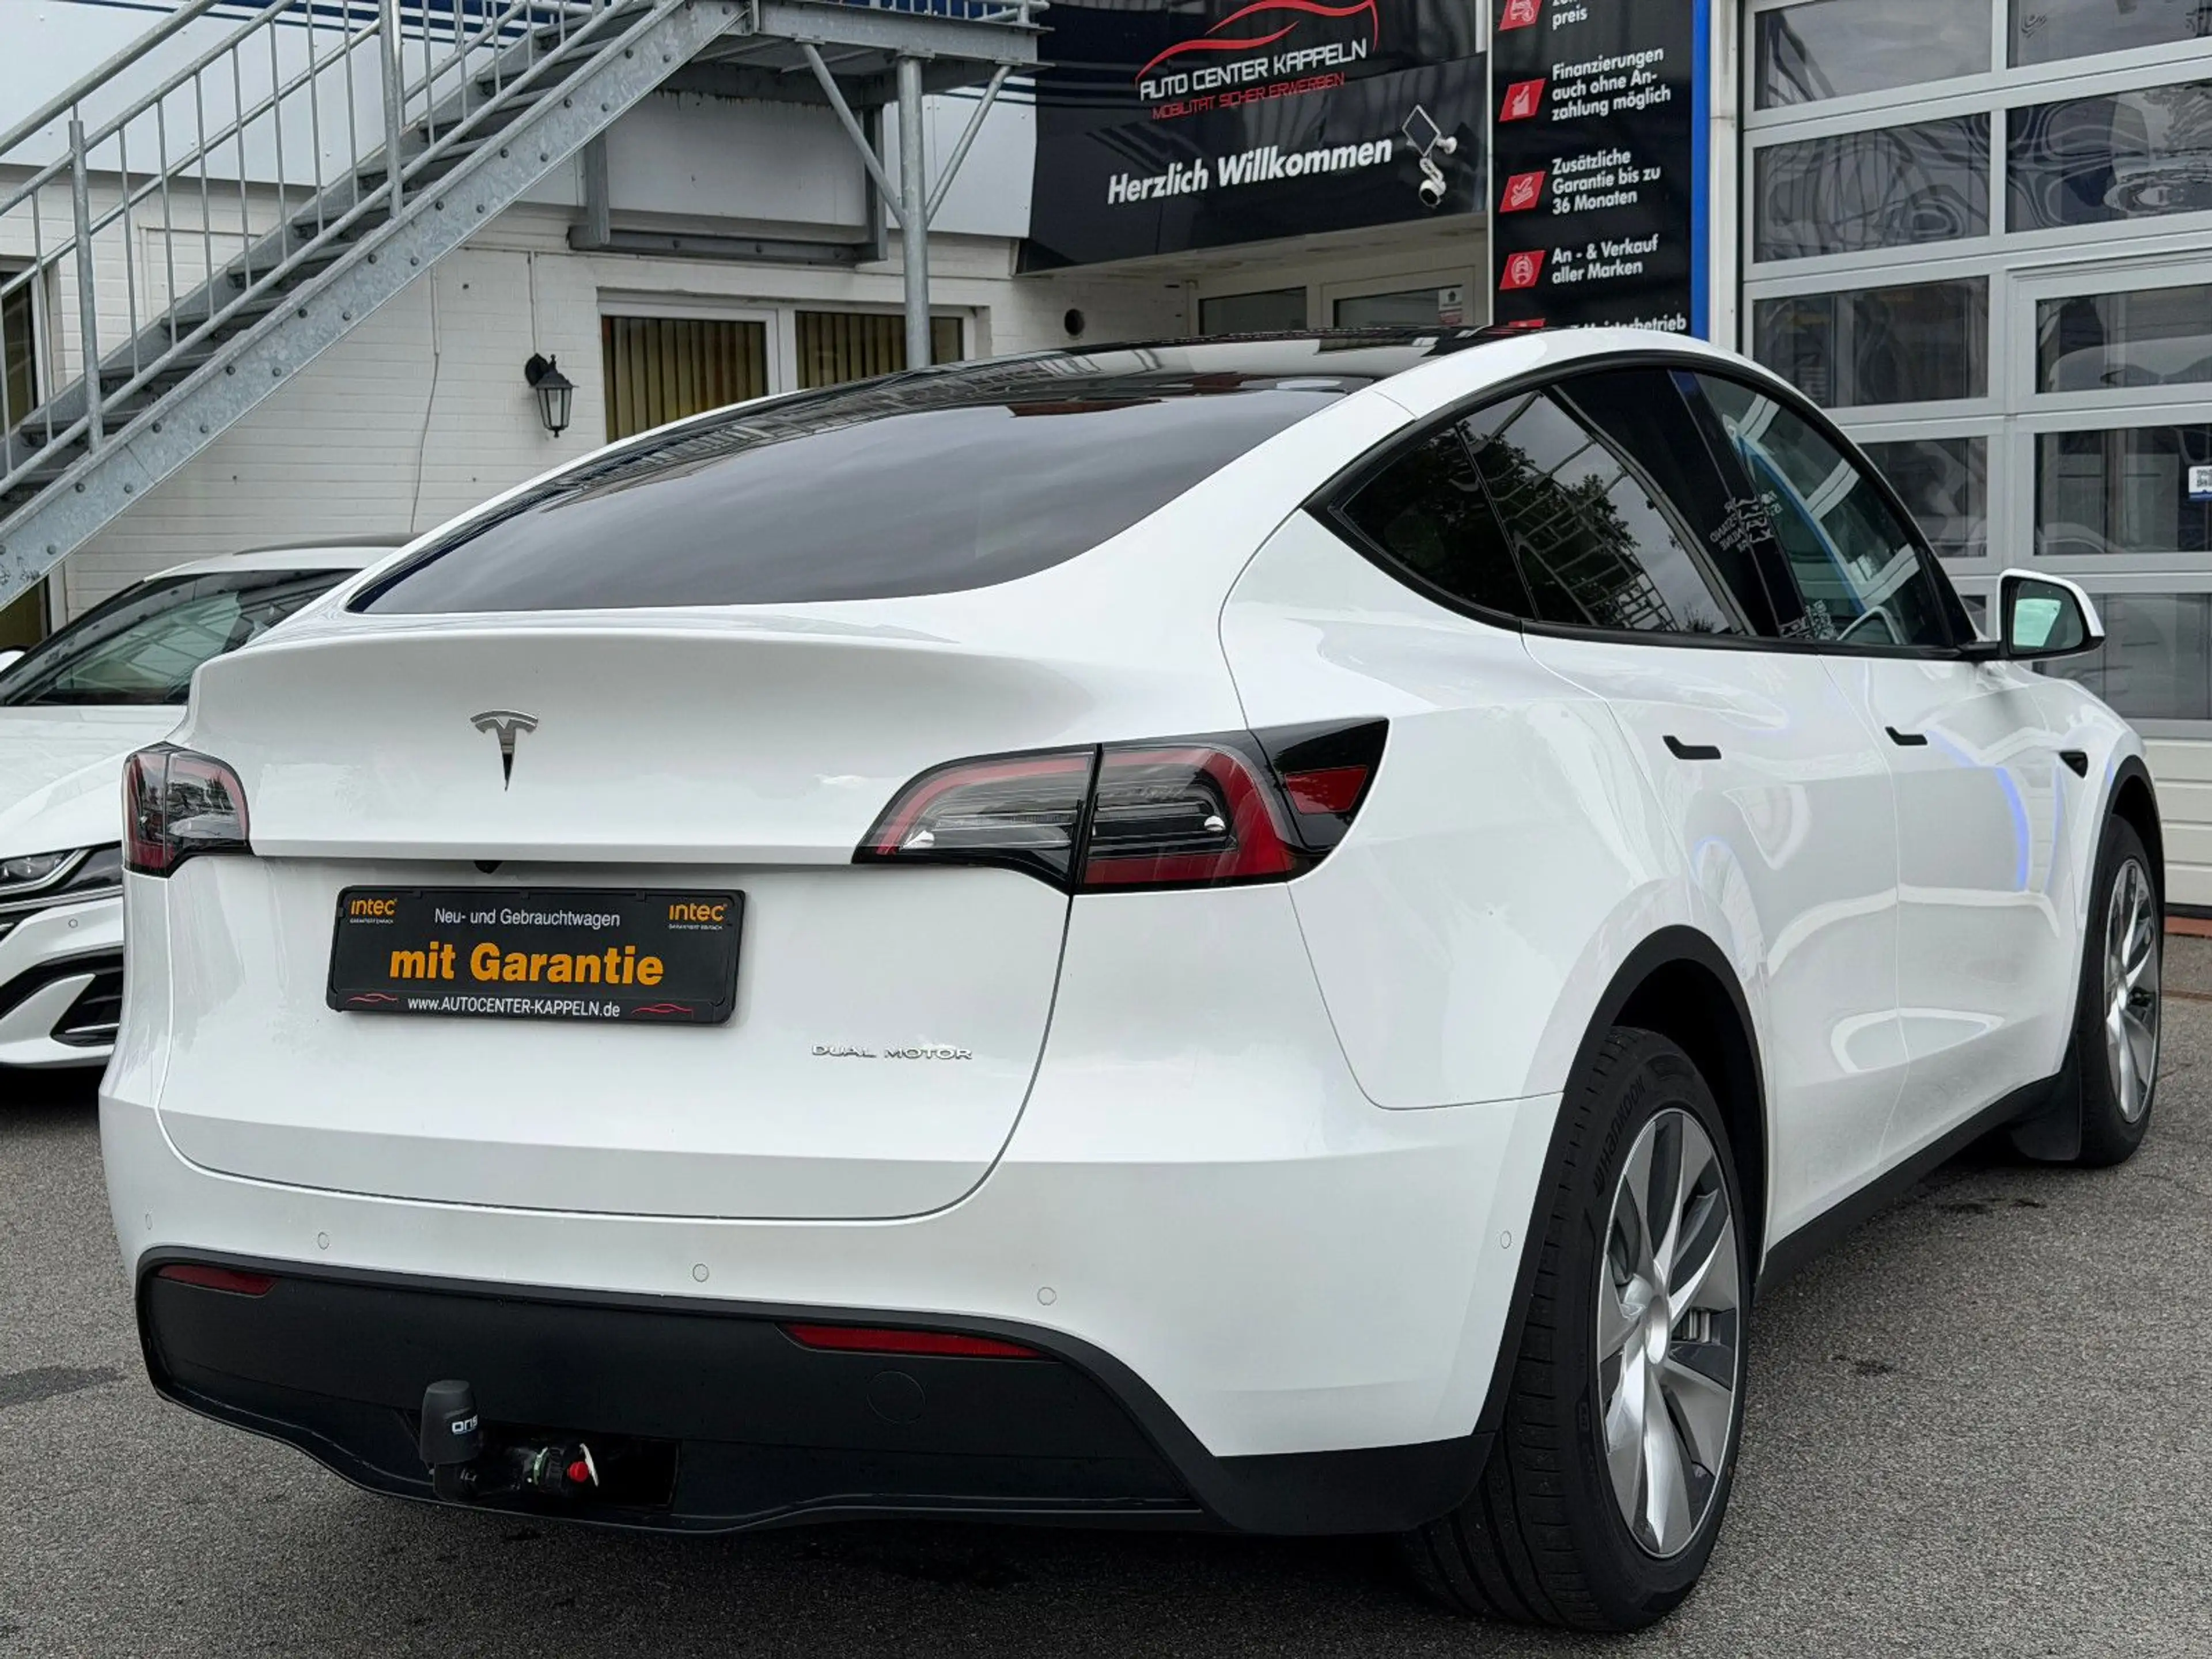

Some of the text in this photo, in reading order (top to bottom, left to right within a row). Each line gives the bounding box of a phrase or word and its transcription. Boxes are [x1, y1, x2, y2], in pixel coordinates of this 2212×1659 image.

[1552, 4, 1588, 31] preis
[1140, 37, 1367, 101] AUTO CENTER KAPPELN
[1552, 48, 1664, 81] Finanzierungen
[1219, 86, 1264, 108] SICHER
[1268, 71, 1345, 98] ERWERBEN
[1552, 69, 1658, 101] auch ohne An-
[1551, 84, 1671, 122] zahlung möglich
[1107, 138, 1392, 205] Herzlich Willkommen
[1552, 147, 1631, 176] Zusätzliche
[1552, 166, 1661, 195] Garantie bis zu
[1552, 191, 1638, 215] 36 Monaten
[1551, 247, 1573, 265] An
[1585, 243, 1598, 260] &
[1600, 232, 1659, 258] Verkauf
[1552, 258, 1643, 285] aller Marken
[434, 907, 620, 930] Neu- und Gebrauchtwagen
[389, 941, 664, 986] mit Garantie
[407, 995, 620, 1018] www.AUTOCENTER-KAPPELN.de
[810, 1044, 974, 1060] DUAL MOTOR
